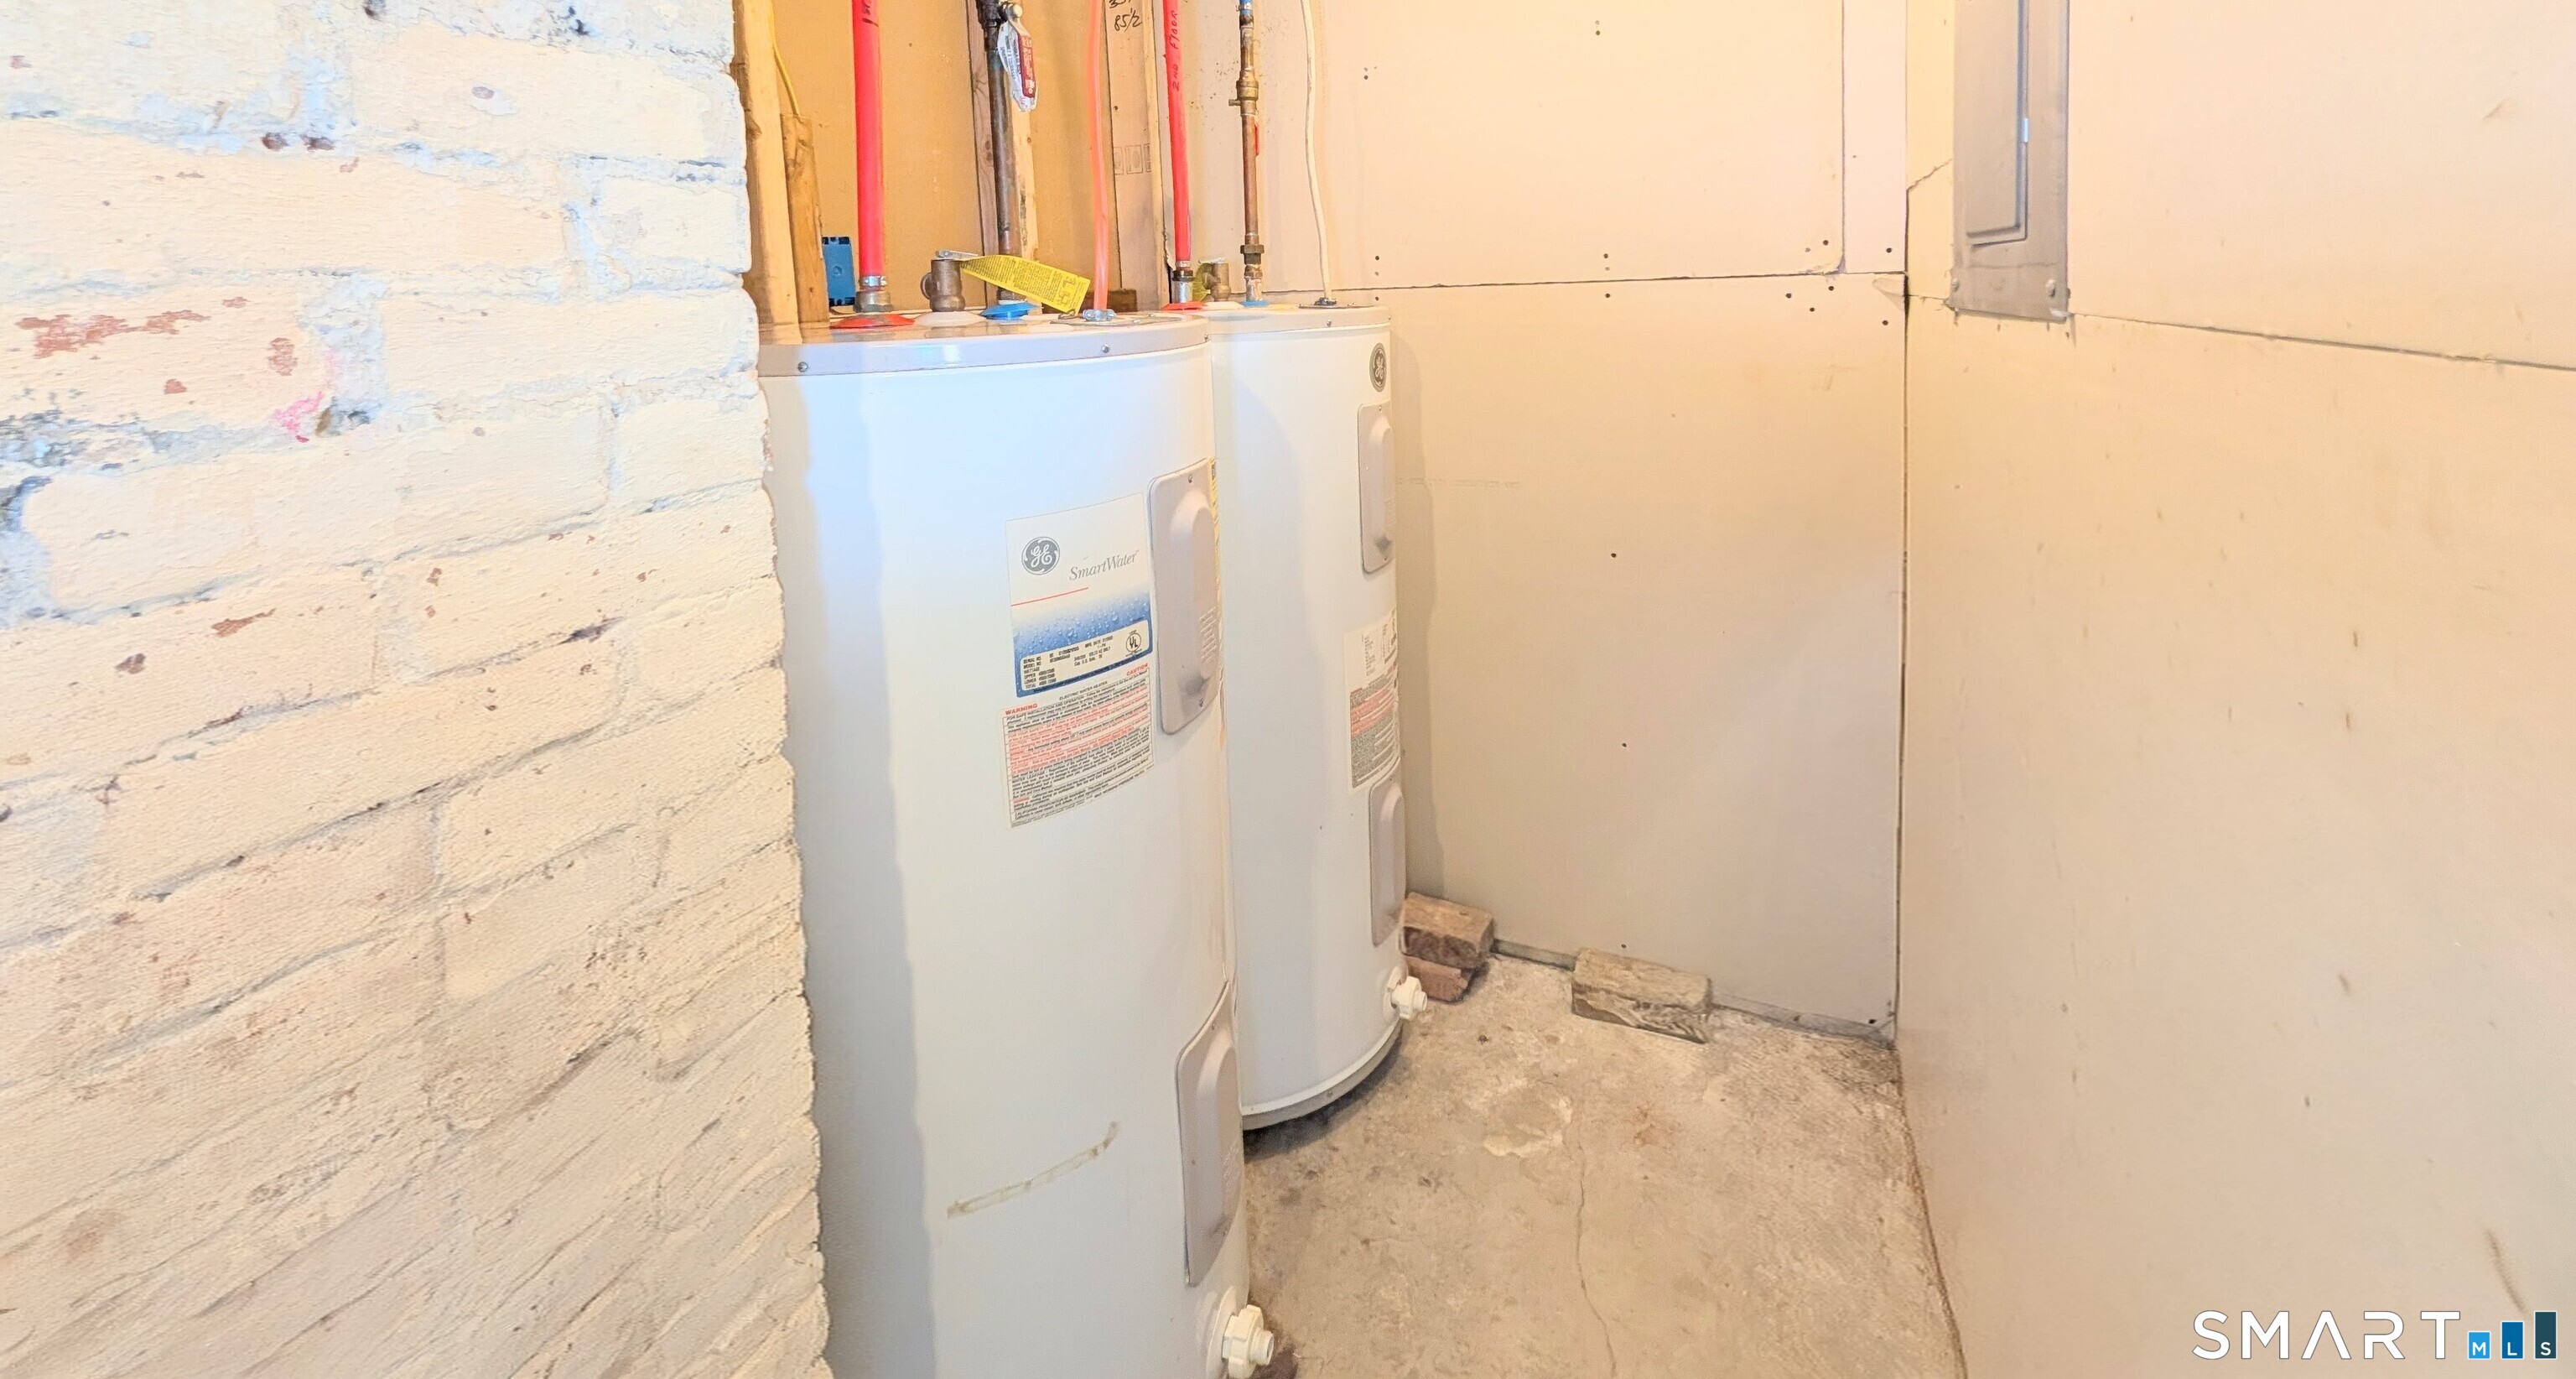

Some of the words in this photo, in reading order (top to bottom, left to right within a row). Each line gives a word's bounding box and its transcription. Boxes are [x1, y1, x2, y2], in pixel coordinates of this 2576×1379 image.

[1068, 553, 1137, 580] SmartWater
[1126, 662, 1149, 676] CAUTION
[1005, 703, 1038, 716] WARNING
